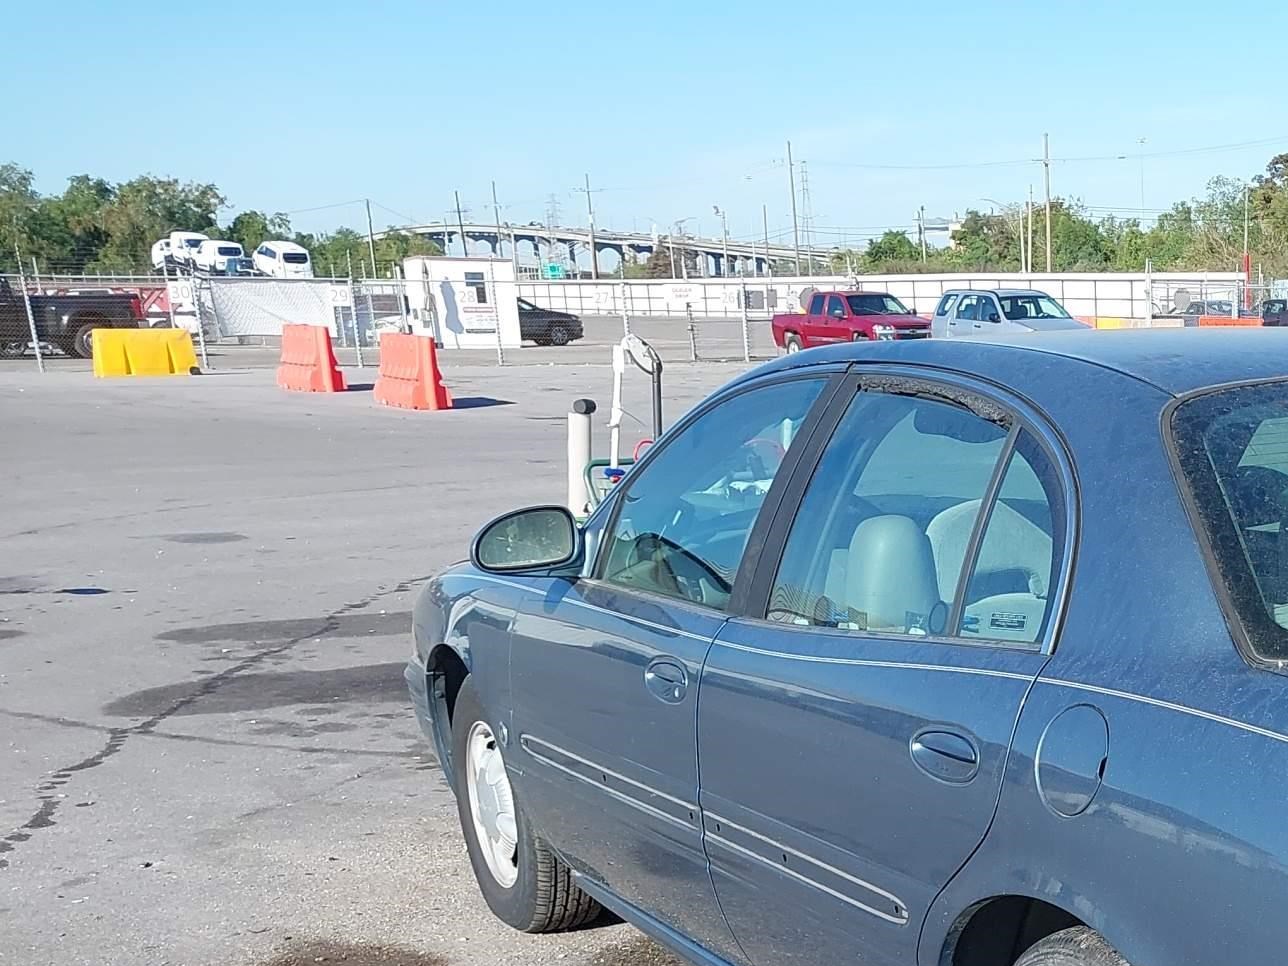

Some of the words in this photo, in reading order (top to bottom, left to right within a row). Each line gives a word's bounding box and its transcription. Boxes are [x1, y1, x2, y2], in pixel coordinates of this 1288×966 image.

[172, 285, 190, 299] 30
[330, 289, 348, 302] 29
[459, 290, 476, 303] 28
[721, 292, 736, 304] 26
